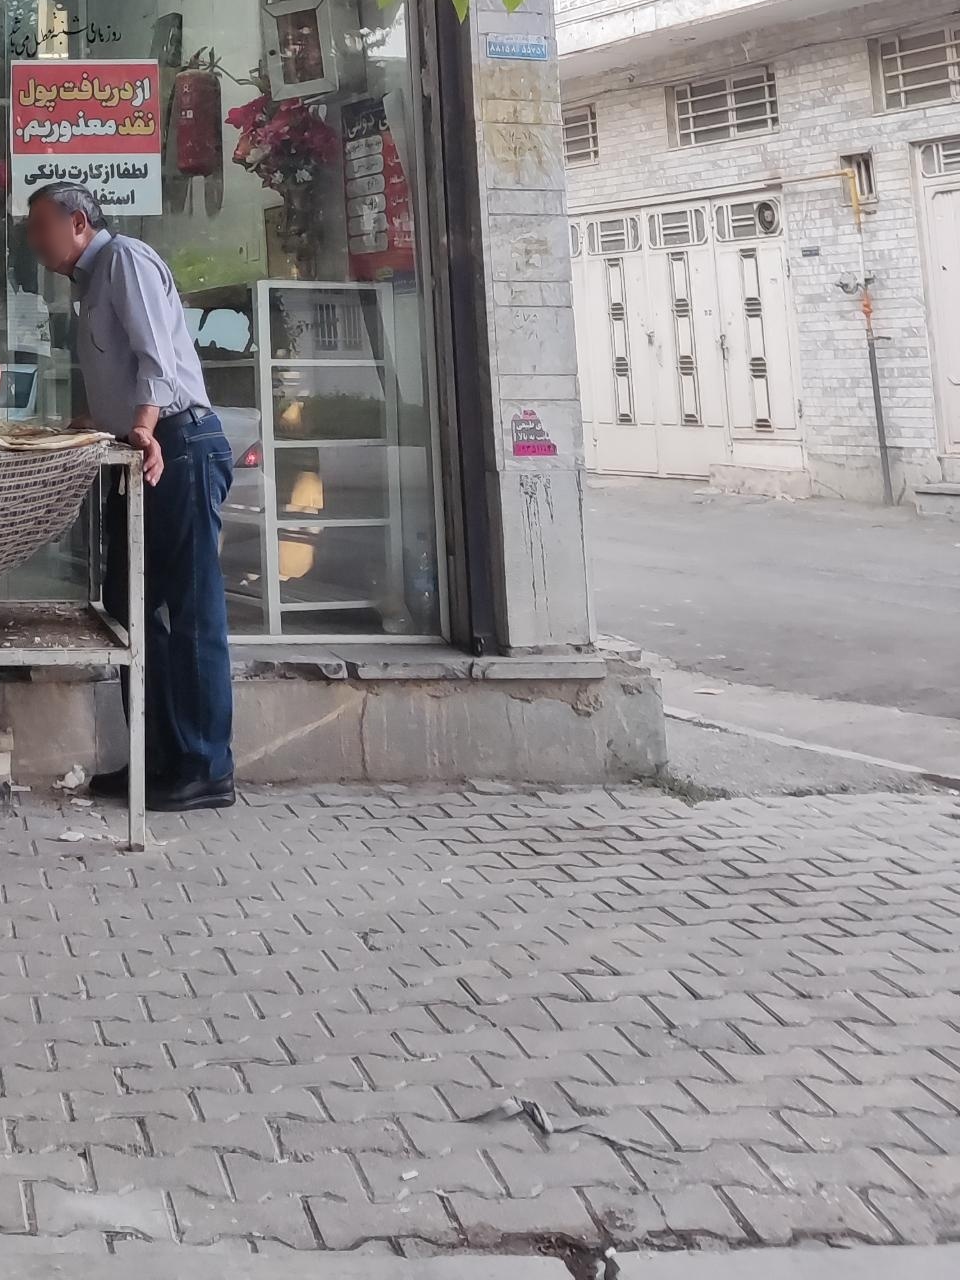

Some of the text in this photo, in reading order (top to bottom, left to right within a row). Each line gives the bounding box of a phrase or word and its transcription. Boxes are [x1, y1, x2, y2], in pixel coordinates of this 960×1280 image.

[51, 16, 88, 45] شنبه
[86, 22, 122, 44] روزهای
[19, 72, 150, 112] از دریافت پول
[16, 110, 155, 141] نقد معذوریم.
[25, 163, 148, 185] لطفا از کارت بانکی
[93, 188, 135, 205] استفا
